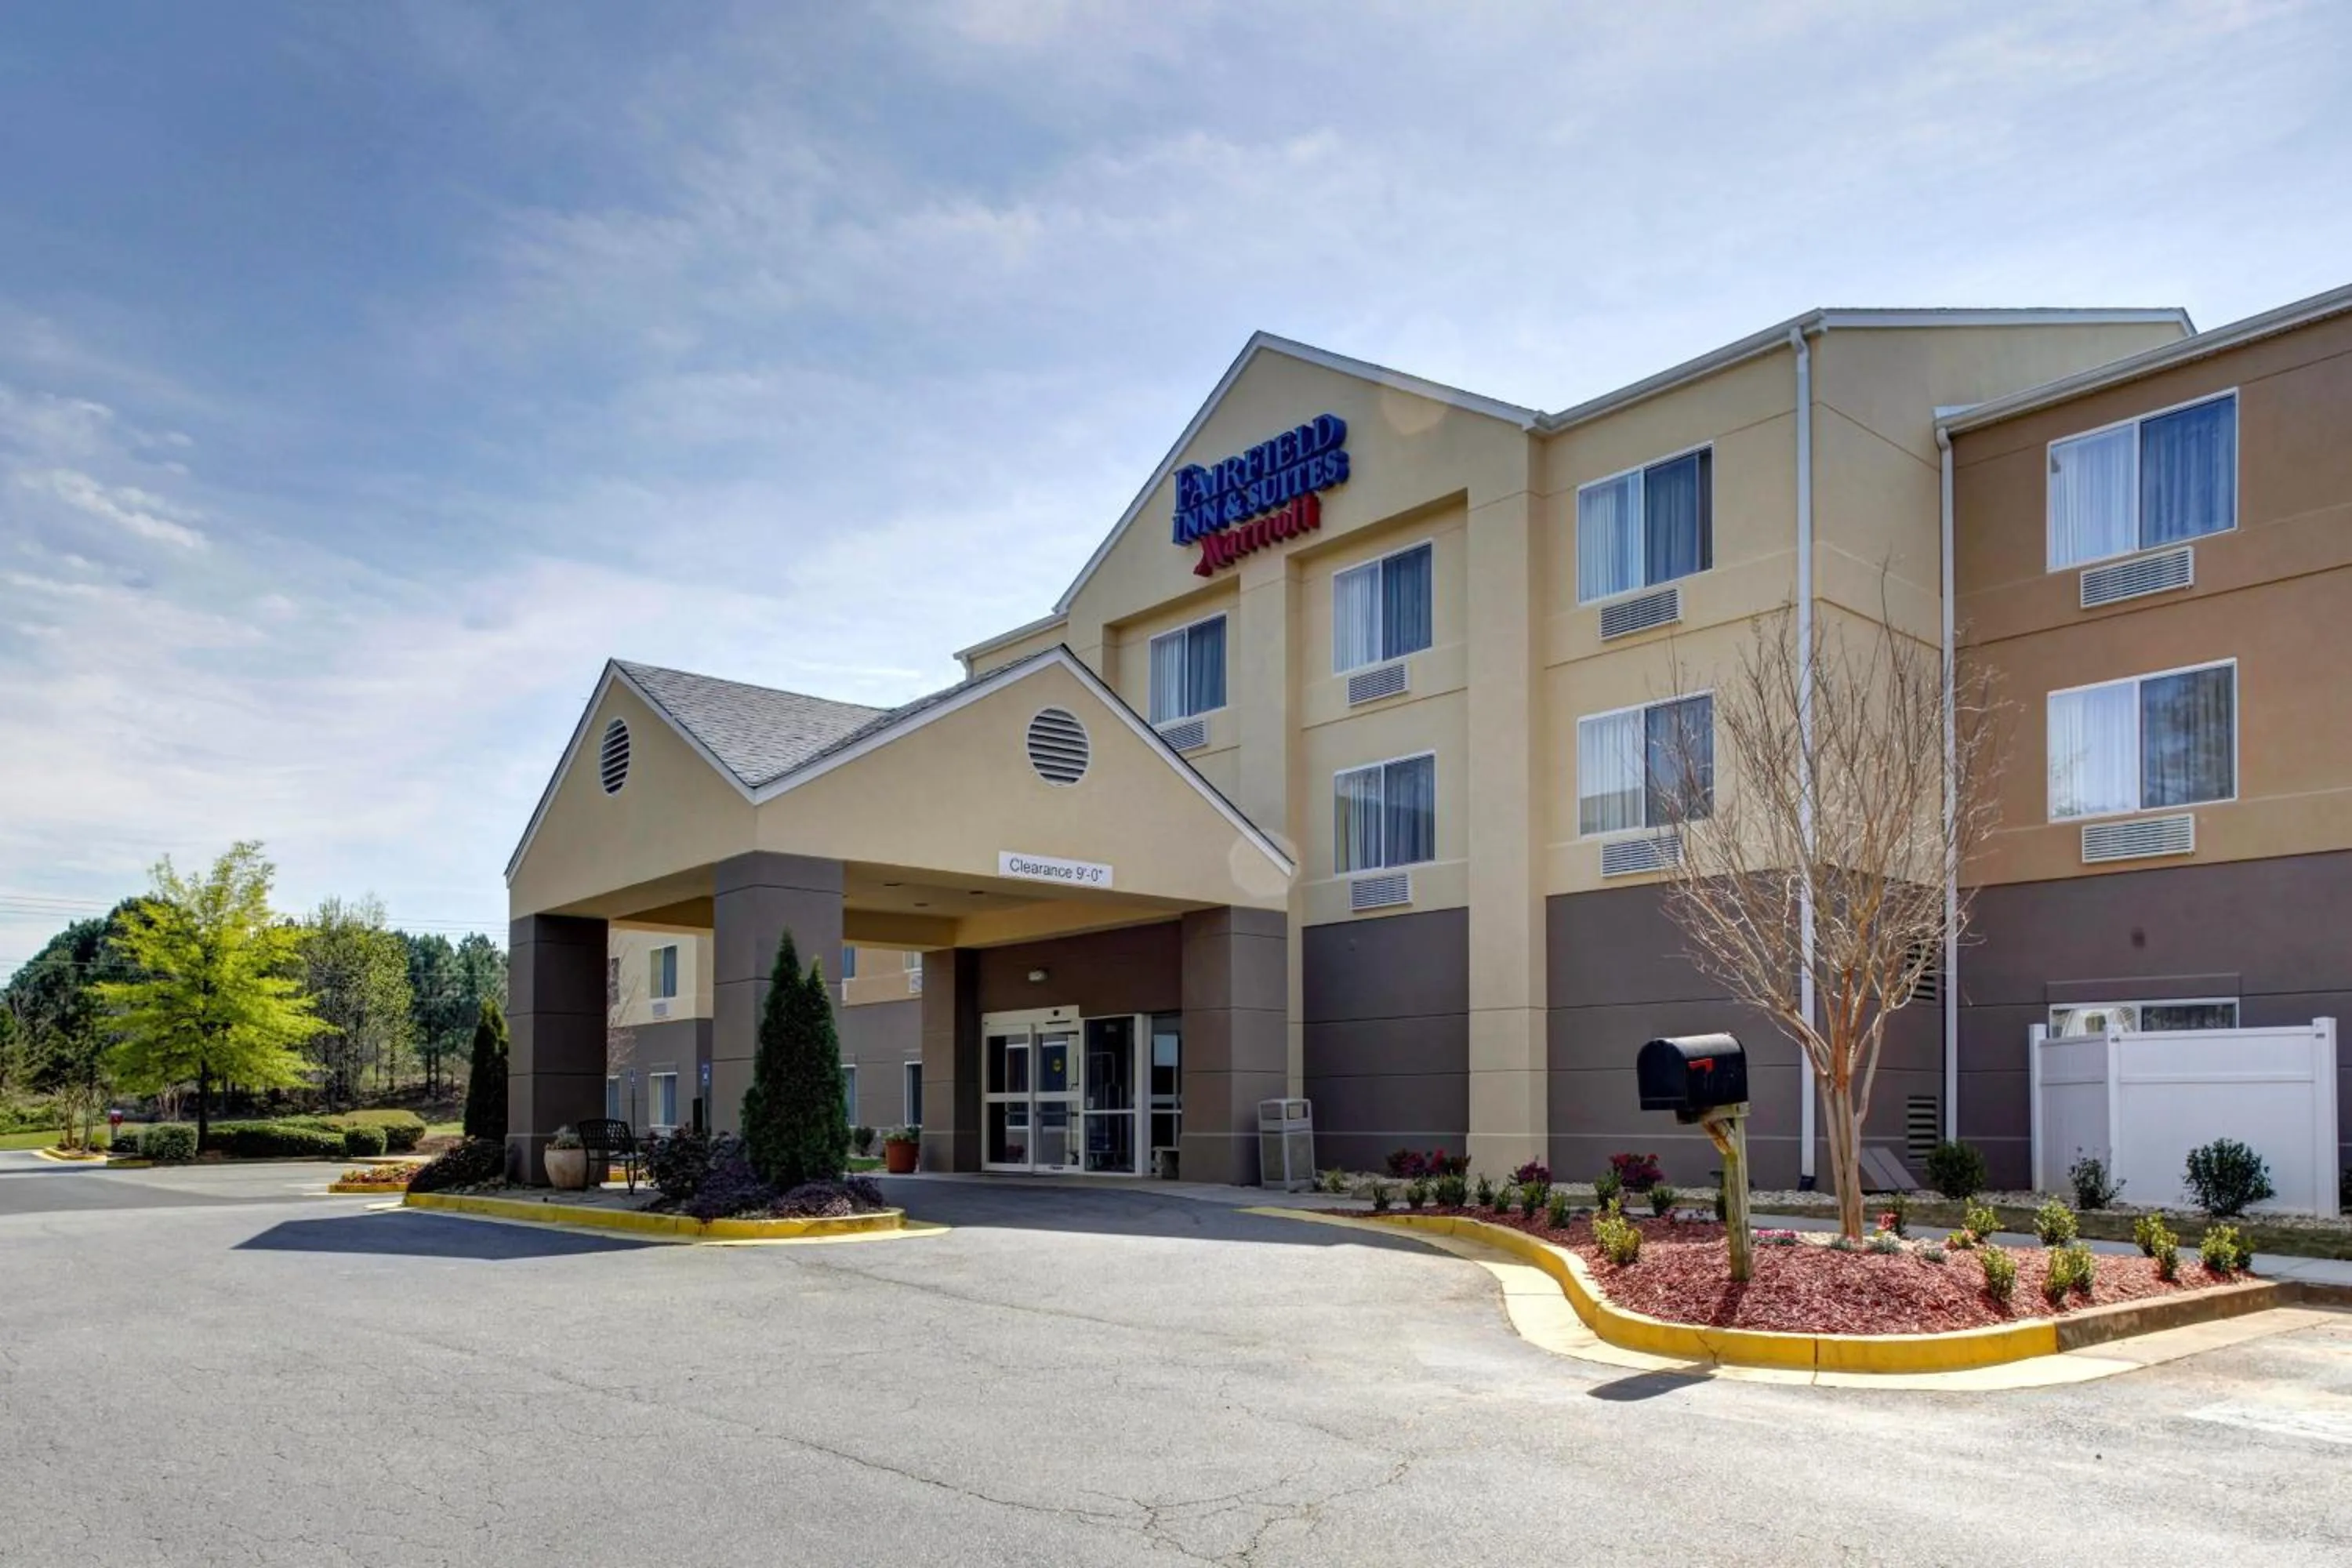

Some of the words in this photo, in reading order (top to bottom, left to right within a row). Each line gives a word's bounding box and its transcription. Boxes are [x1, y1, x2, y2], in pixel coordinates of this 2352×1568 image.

[1172, 498, 1225, 545] INN
[1224, 493, 1250, 522] &
[1245, 449, 1349, 515] SUITES
[1174, 413, 1347, 514] FAIRFIELD
[1192, 492, 1321, 577] Marriott
[1009, 857, 1073, 879] Clearance
